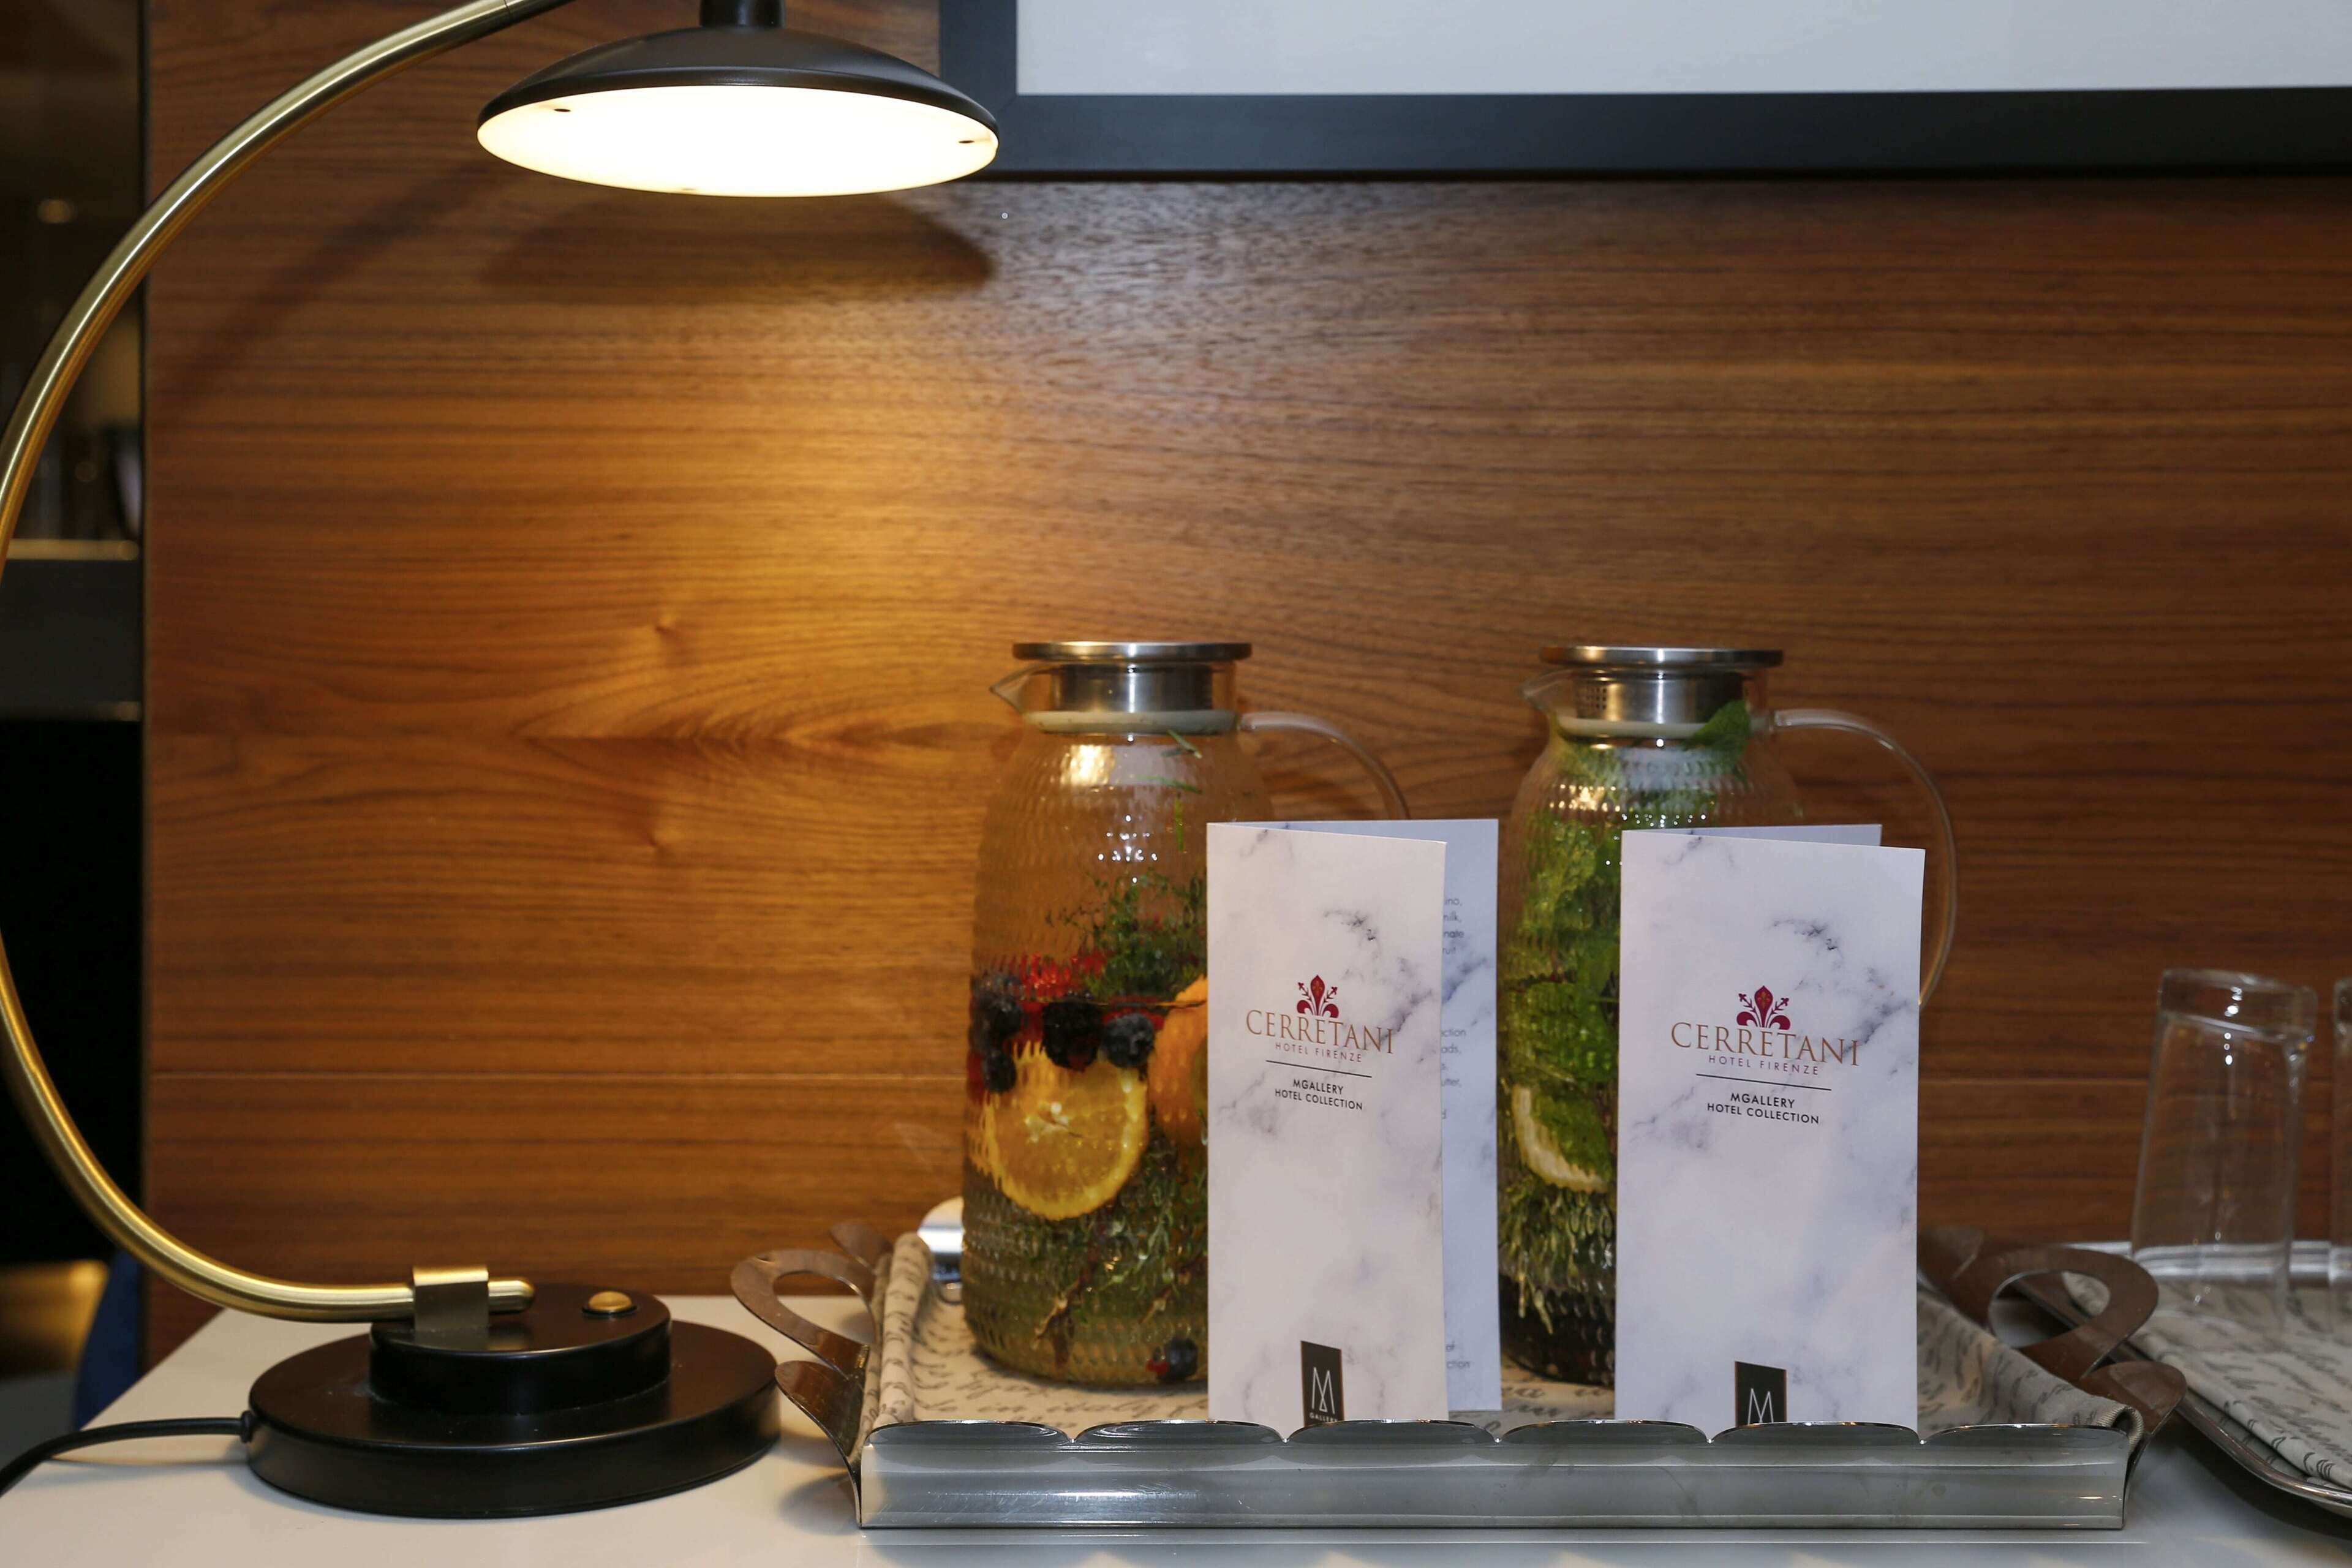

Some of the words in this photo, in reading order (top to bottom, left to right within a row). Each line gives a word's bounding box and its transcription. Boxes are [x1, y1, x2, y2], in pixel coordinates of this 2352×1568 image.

[1246, 1009, 1393, 1054] CERRETANI
[1275, 1042, 1308, 1055] HOTEL
[1315, 1047, 1363, 1063] FIRENZE
[1671, 1022, 1860, 1066] CERRETANI
[1708, 1055, 1751, 1068] HOTEL
[1760, 1060, 1819, 1076] FIRENZE
[1292, 1079, 1344, 1095] MGALLERY
[1275, 1088, 1303, 1101] HOTEL
[1305, 1093, 1363, 1110] COLLECTION
[1730, 1092, 1795, 1109] MGALLERY
[1707, 1102, 1742, 1115] HOTEL
[1746, 1107, 1819, 1125] COLLECTION
[1311, 1366, 1336, 1415] M
[1747, 1387, 1774, 1425] M
